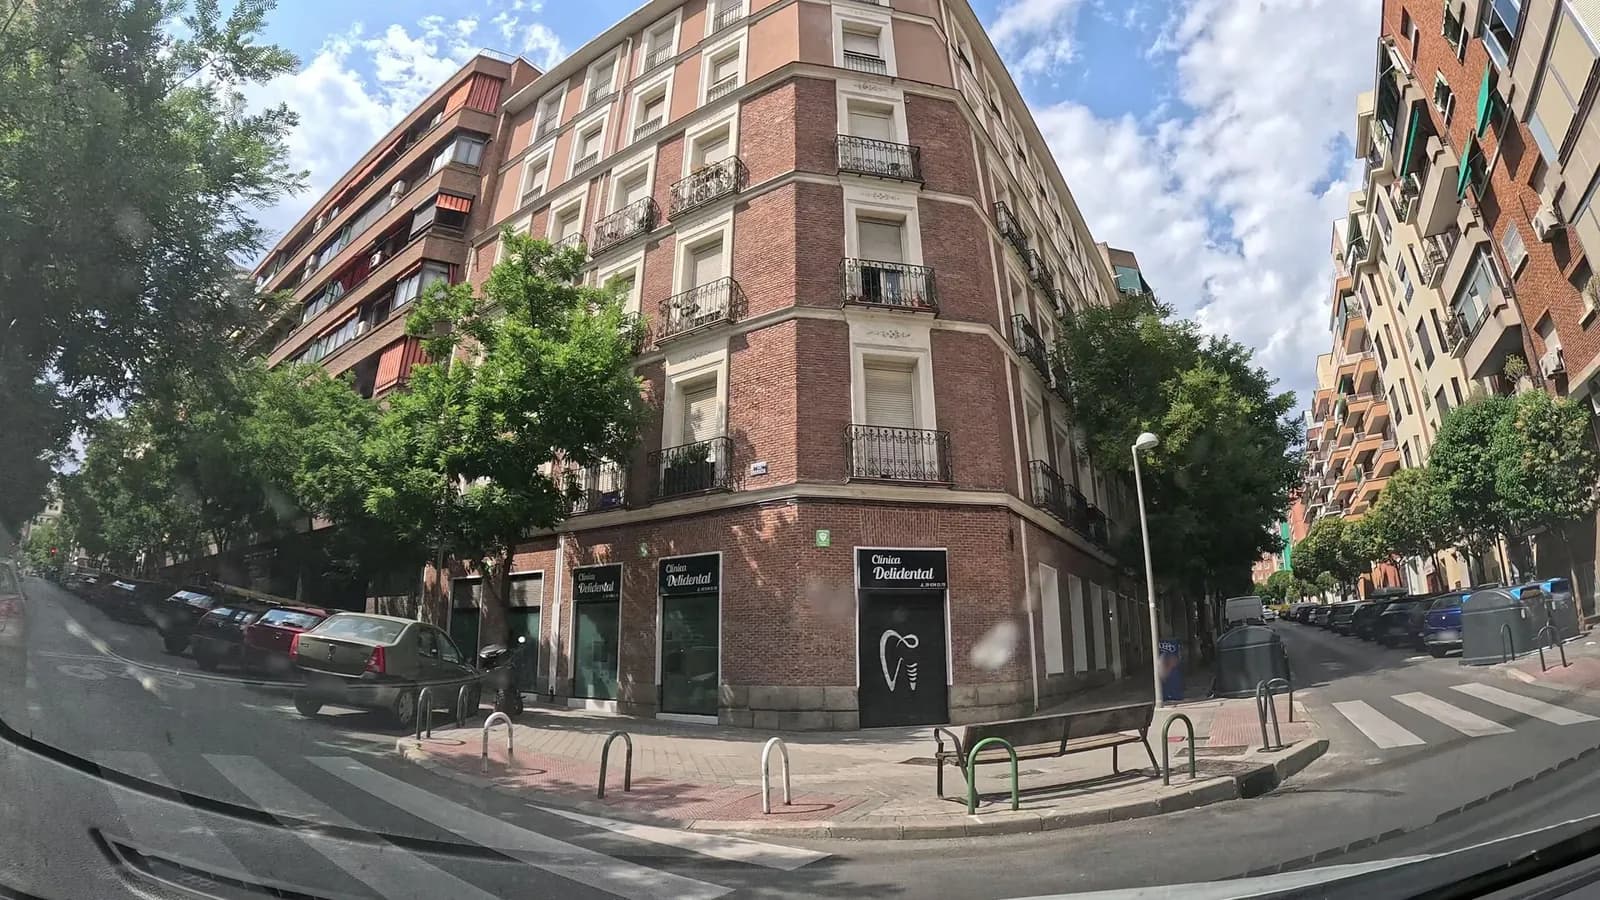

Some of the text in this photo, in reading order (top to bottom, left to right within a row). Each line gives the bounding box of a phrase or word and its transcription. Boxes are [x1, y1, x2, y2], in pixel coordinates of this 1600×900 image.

[871, 553, 902, 565] Clínica
[666, 571, 712, 587] Delidental
[872, 566, 935, 580] Delidental
